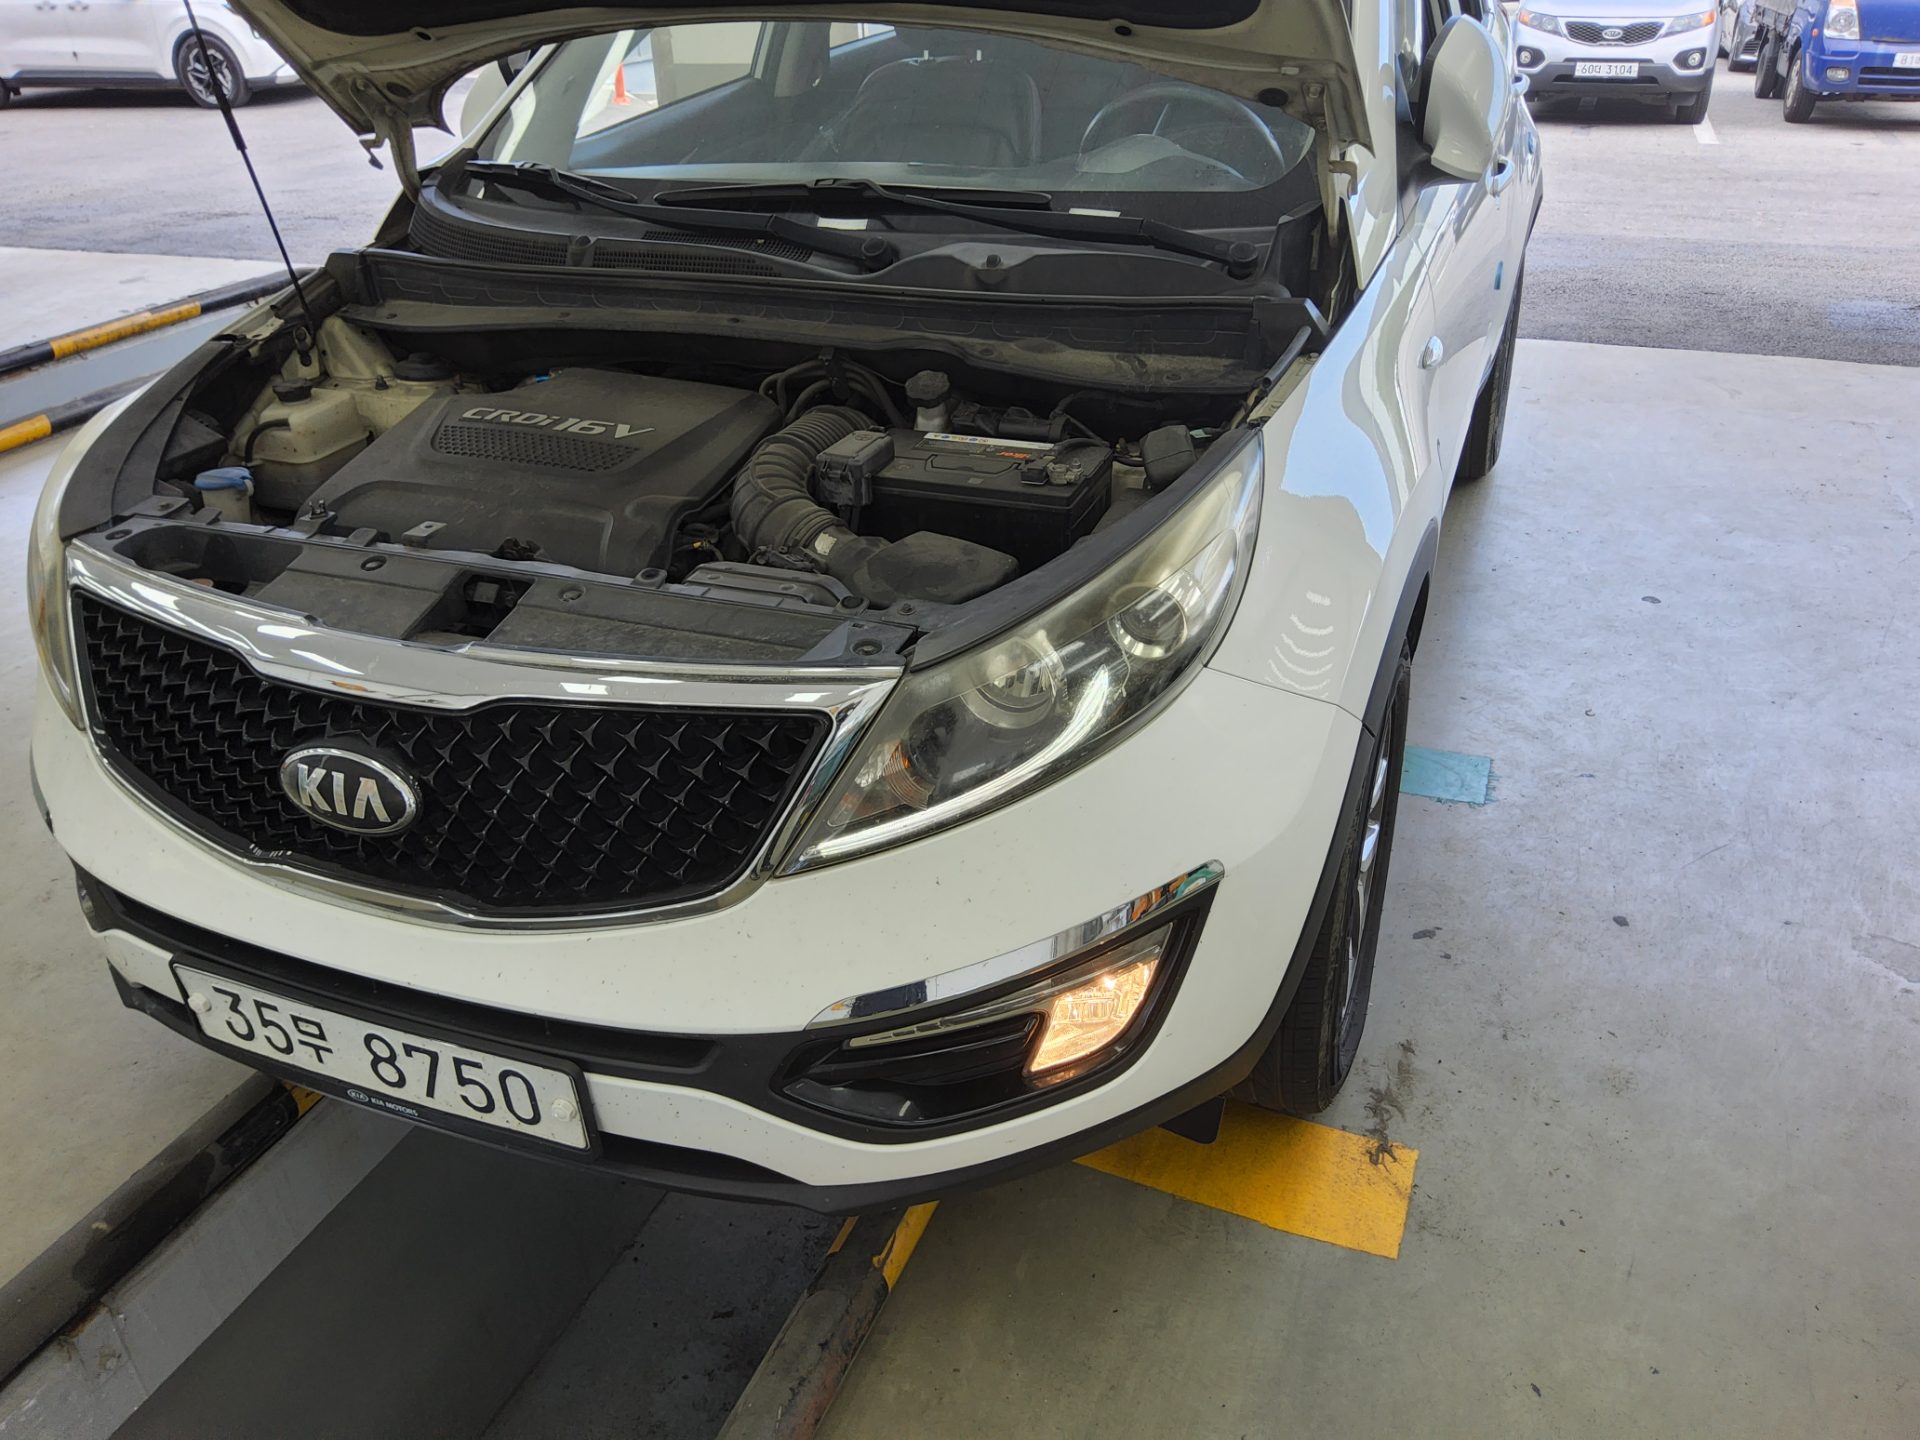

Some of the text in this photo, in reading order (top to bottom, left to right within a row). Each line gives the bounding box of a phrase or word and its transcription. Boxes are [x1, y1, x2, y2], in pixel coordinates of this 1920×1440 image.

[1606, 64, 1632, 75] 3104
[297, 762, 392, 823] KIA
[211, 985, 542, 1126] 35무 8750
[370, 1097, 418, 1116] KIA MOTORS
